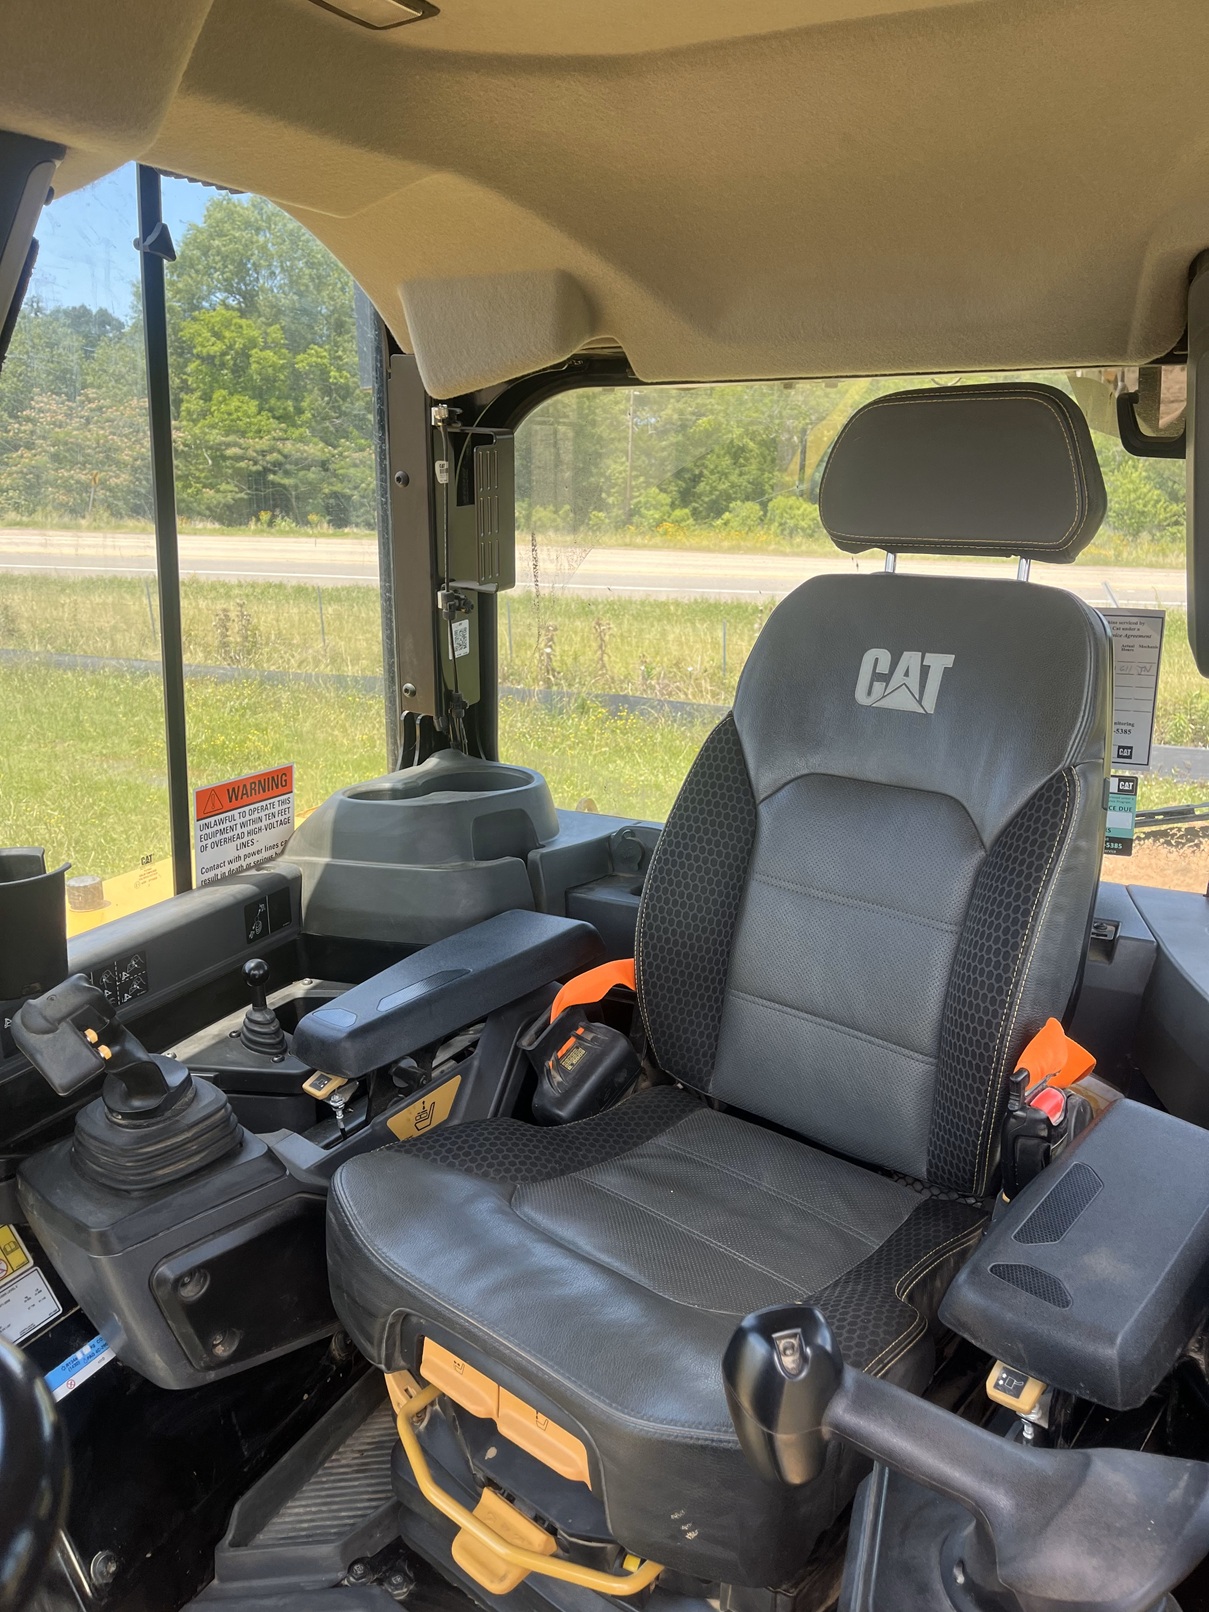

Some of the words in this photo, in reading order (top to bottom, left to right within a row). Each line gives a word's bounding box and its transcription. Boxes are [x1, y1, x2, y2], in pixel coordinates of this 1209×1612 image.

[855, 648, 955, 714] CAT
[1118, 748, 1132, 756] CAT
[226, 773, 288, 803] WARNING
[1119, 781, 1134, 790] CAT
[199, 815, 236, 832] UNLAWFUL
[238, 810, 246, 819] TO
[248, 803, 275, 816] OPERATE
[277, 797, 291, 807] THIS
[199, 824, 238, 842] EQUIPMENT
[239, 816, 263, 829] WITHIN
[264, 812, 276, 822] TEN
[277, 807, 291, 818] FEET
[199, 844, 209, 853] OF
[210, 832, 245, 850] OVERHEAD
[246, 816, 291, 837] HIGH-VOLTAGE
[235, 838, 255, 851] LINES
[141, 854, 152, 866] CAT
[200, 859, 226, 875] Contact
[227, 853, 242, 866] with
[243, 847, 263, 862] power
[264, 842, 280, 853] lines
[200, 872, 219, 886] result
[220, 870, 227, 879] in
[227, 862, 245, 876] death
